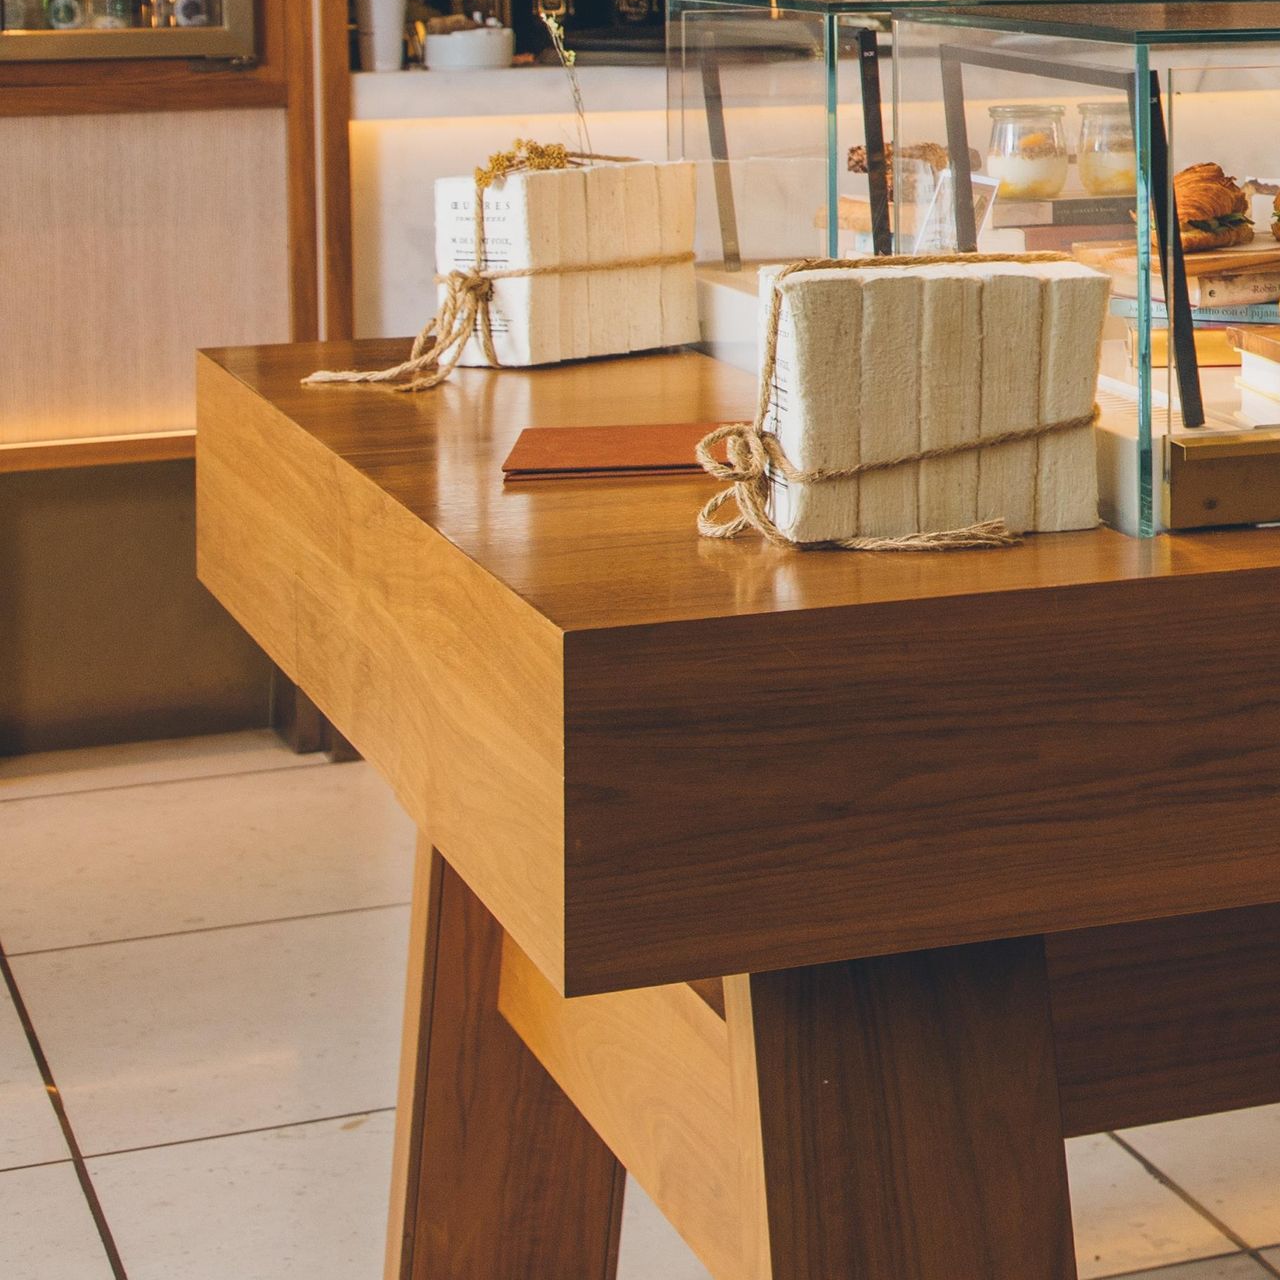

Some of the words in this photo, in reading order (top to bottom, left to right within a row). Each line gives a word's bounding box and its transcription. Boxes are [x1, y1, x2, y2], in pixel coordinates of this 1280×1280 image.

[450, 201, 511, 210] ŒURES
[1221, 309, 1238, 317] con
[1240, 307, 1249, 317] el
